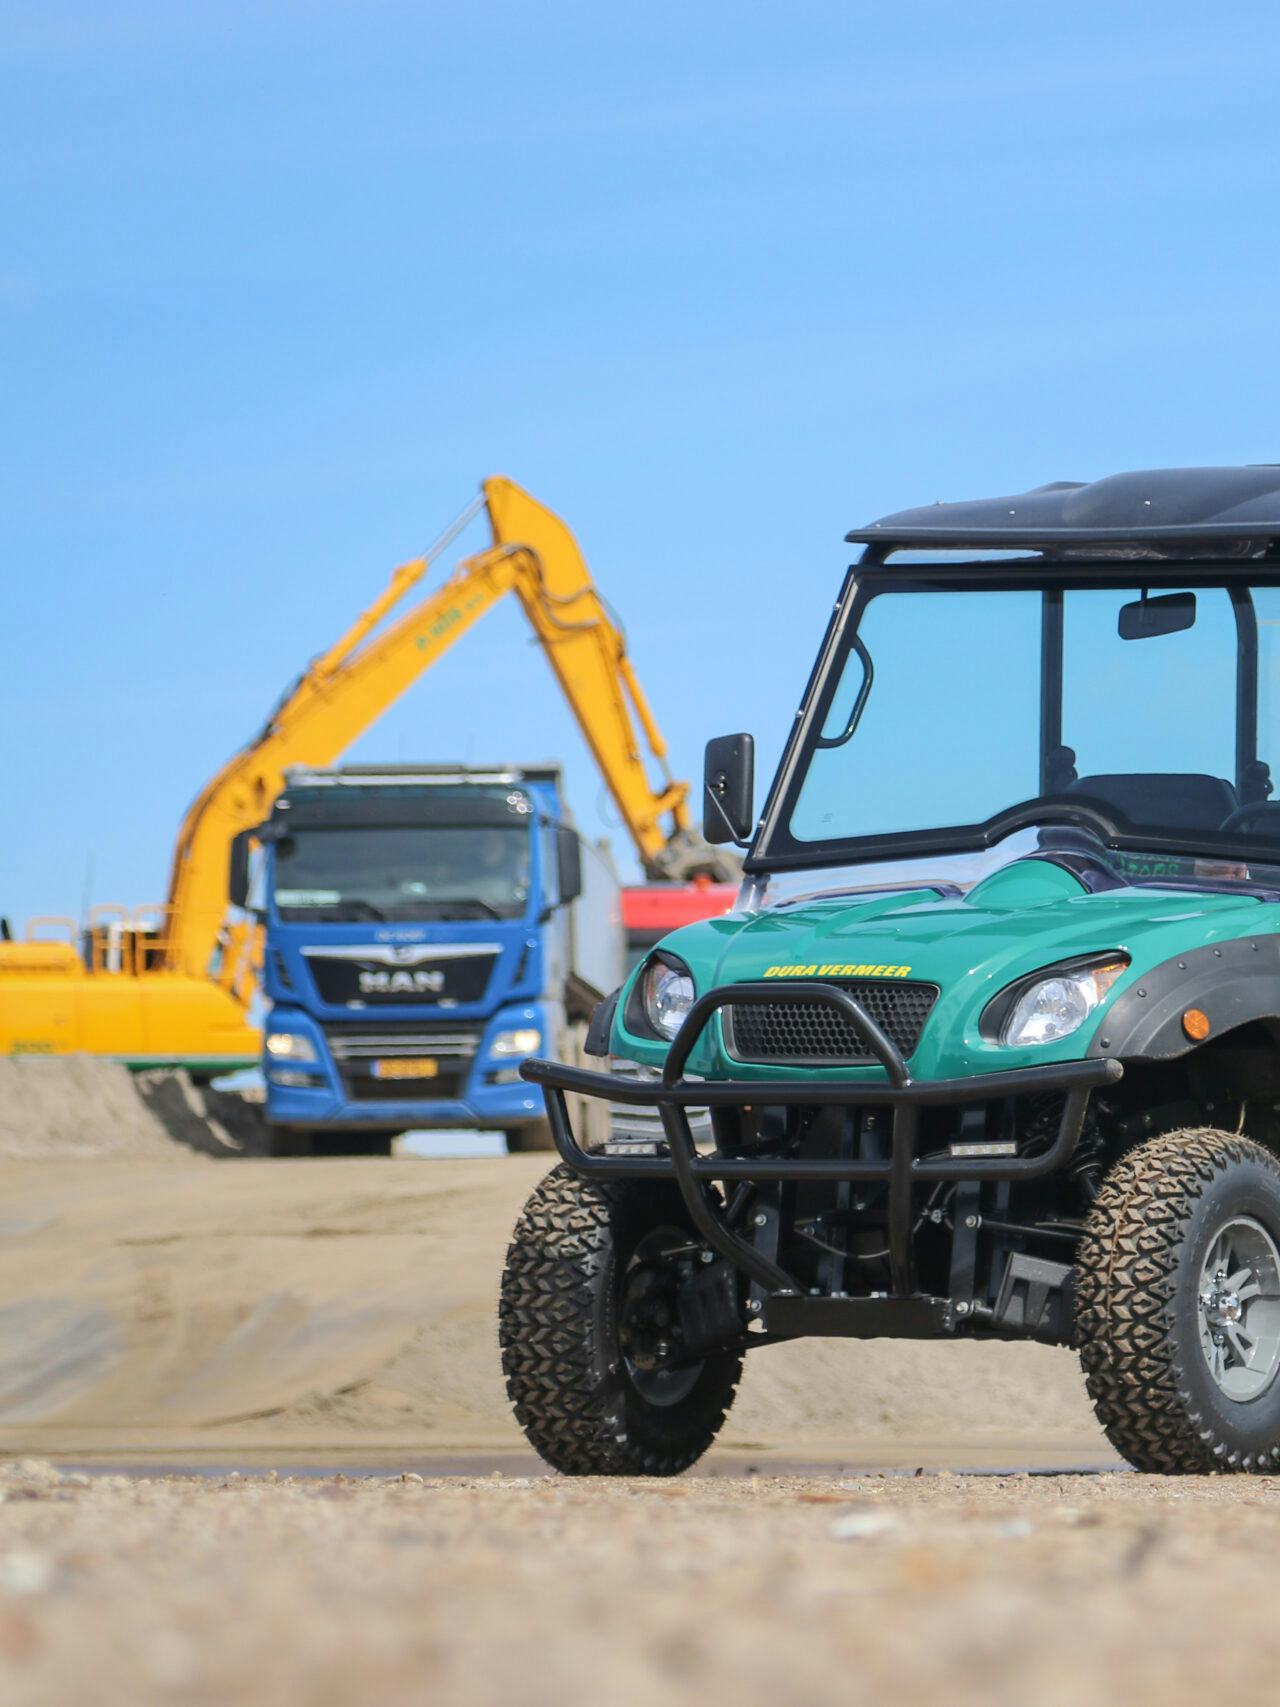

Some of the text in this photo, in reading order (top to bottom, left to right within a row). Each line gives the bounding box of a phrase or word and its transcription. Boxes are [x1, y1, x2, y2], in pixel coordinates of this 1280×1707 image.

[763, 965, 912, 977] DURA VERMEER
[359, 971, 445, 993] MAN
